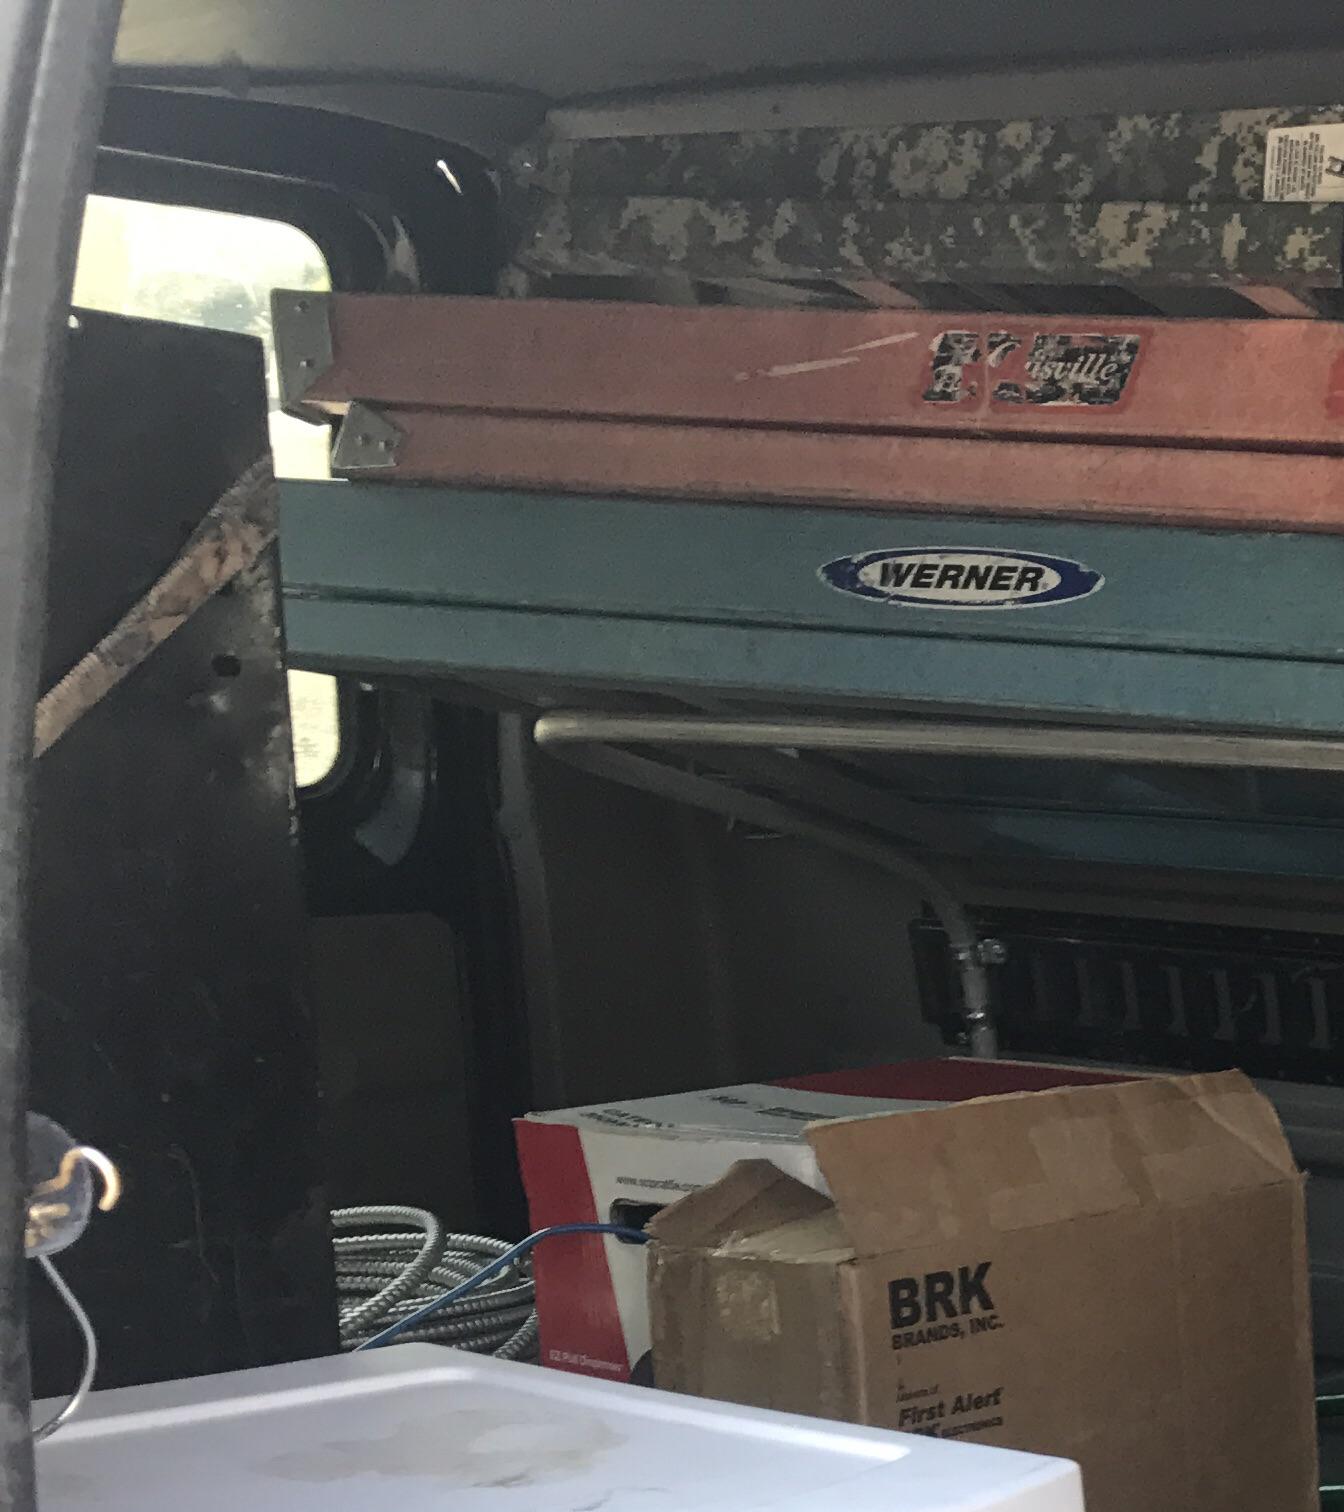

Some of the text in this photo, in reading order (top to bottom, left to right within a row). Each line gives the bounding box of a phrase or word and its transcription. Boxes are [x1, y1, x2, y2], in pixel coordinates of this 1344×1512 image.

[879, 562, 1045, 592] WERNER
[888, 1260, 994, 1330] BRK
[891, 1314, 1006, 1351] BRANDS, INC.
[898, 1400, 946, 1428] First
[949, 1387, 1005, 1416] Alert
